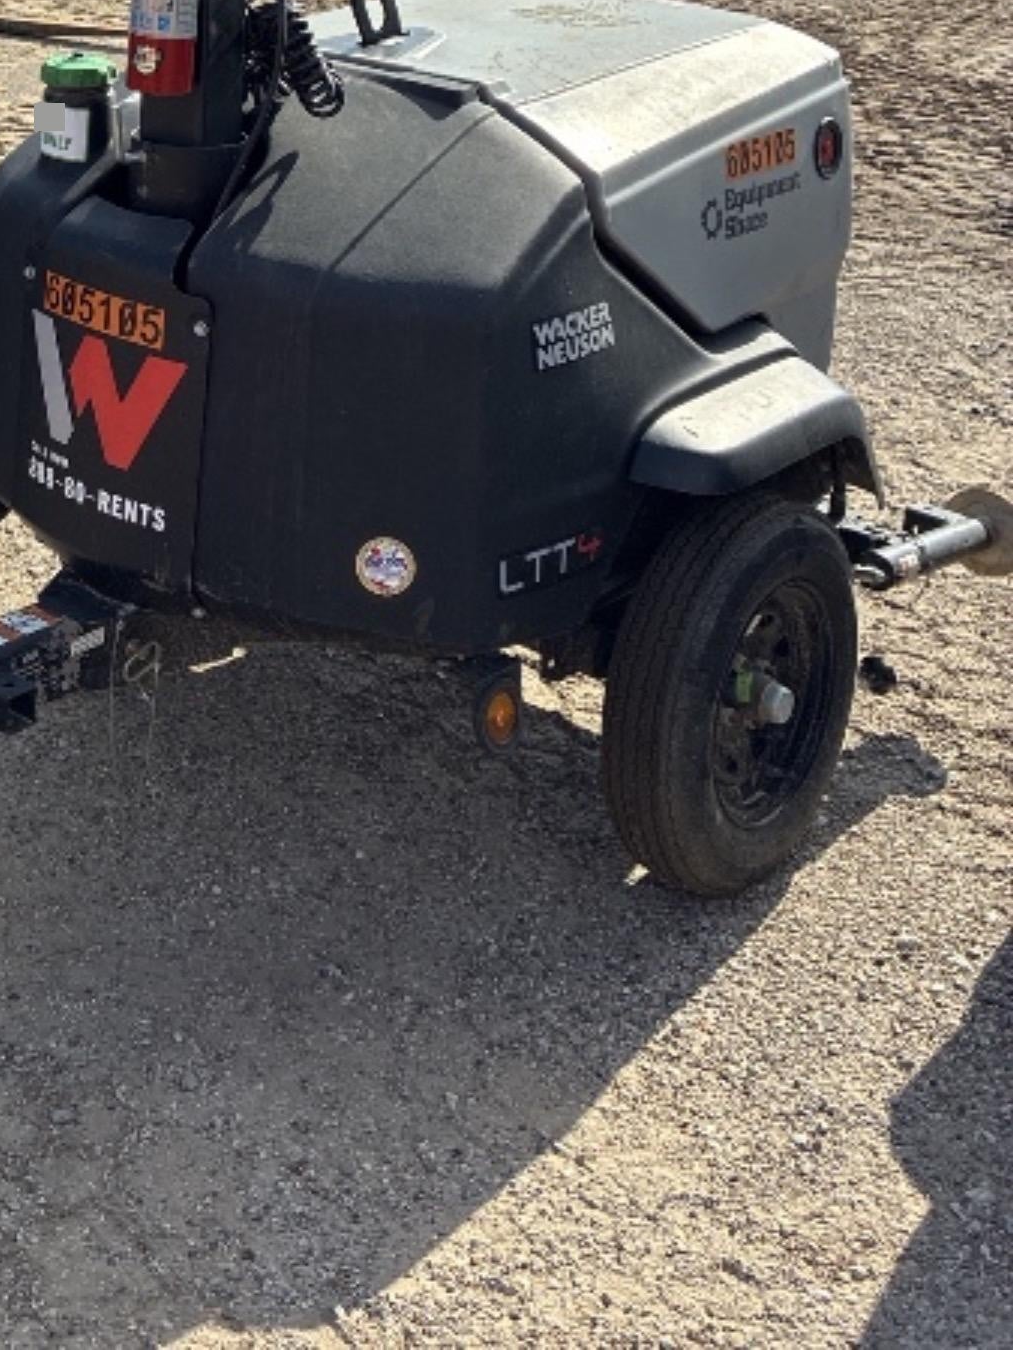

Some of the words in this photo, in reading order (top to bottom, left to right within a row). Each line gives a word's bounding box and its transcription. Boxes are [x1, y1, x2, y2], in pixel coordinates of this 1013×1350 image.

[724, 172, 802, 212] Equipment
[46, 273, 162, 347] 605105
[533, 303, 610, 347] WACKER
[538, 326, 615, 371] NEUSON
